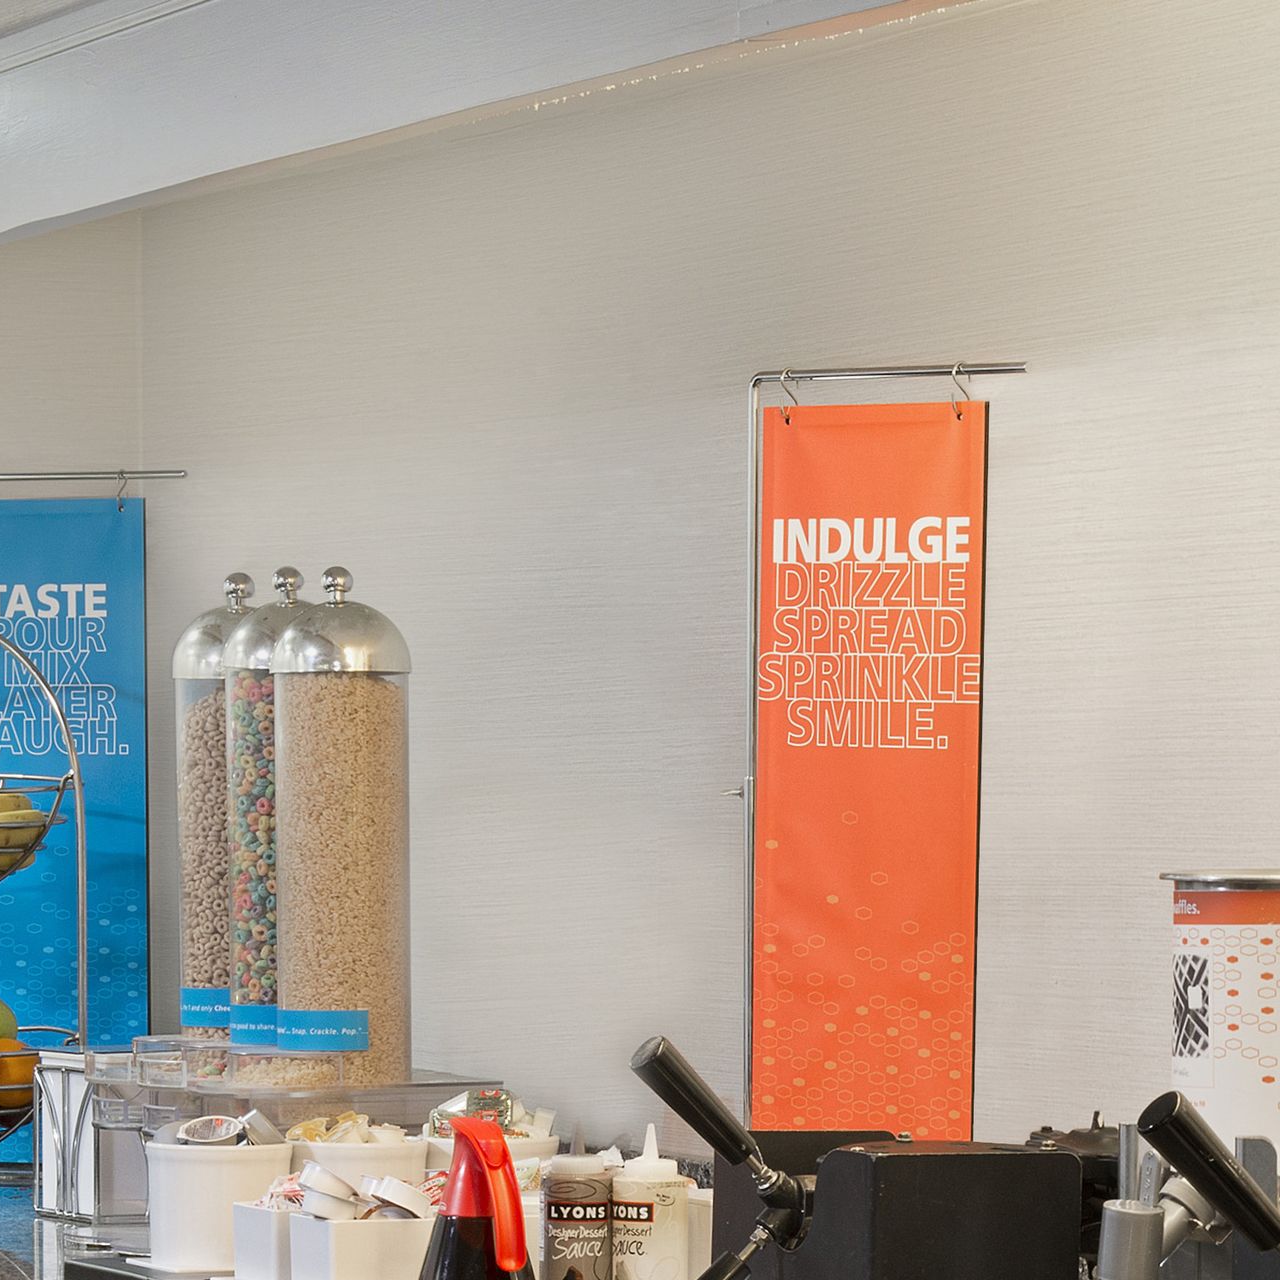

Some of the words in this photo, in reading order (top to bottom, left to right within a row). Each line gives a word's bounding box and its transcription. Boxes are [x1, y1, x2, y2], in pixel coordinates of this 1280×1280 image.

[773, 517, 970, 563] INDULGE
[775, 561, 966, 609] DRIZZLE
[773, 607, 966, 655] SPREAD
[4, 650, 90, 687] MIX
[758, 653, 980, 703] SPRINKLE
[787, 698, 949, 749] SMILE.
[1174, 899, 1200, 915] affles.
[310, 1027, 339, 1035] Crackle.
[551, 1206, 606, 1219] LYONS
[552, 1238, 603, 1260] Sauce
